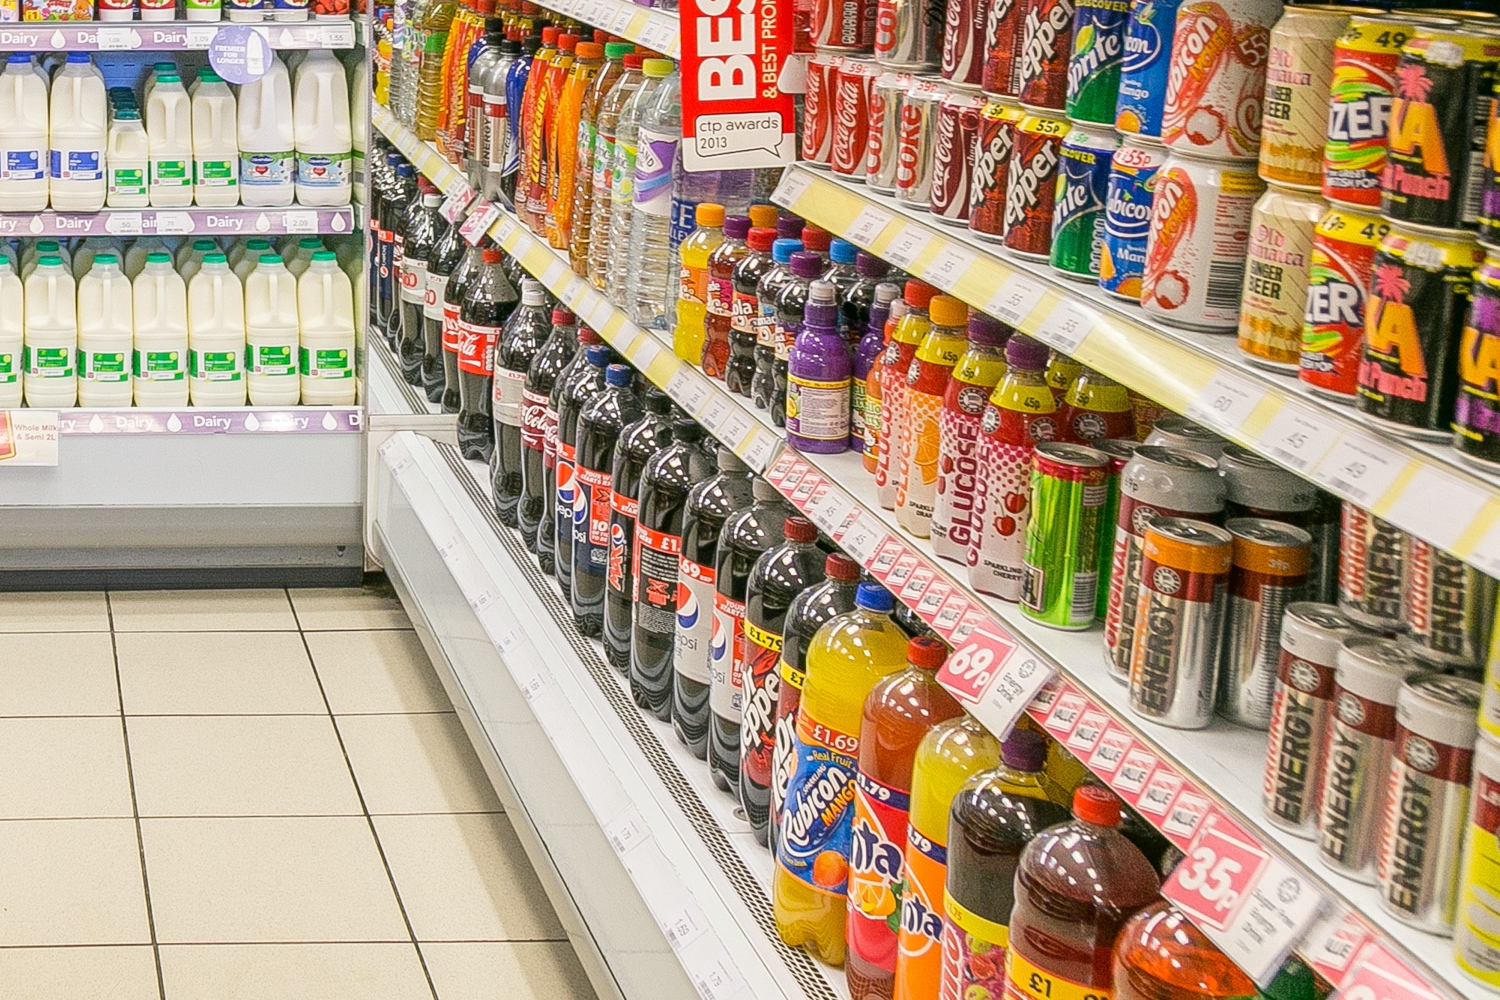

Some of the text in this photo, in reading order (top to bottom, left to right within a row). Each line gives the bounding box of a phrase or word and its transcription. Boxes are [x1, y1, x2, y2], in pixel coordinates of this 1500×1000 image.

[1, 32, 39, 46] Dairy
[762, 43, 778, 79] BEST
[1066, 31, 1121, 94] Sprite
[763, 83, 777, 99] &
[699, 116, 778, 134] ctp awards
[699, 136, 728, 151] 2013
[896, 102, 923, 188] COKE
[55, 215, 92, 230] Dairy
[1249, 280, 1281, 301] BEER
[15, 423, 57, 432] Whole Milk
[25, 433, 43, 441] Semi
[45, 433, 56, 441] 2L
[875, 370, 895, 488] GLUCOSE
[896, 400, 914, 508] GLUCOSE
[951, 419, 980, 546] GLUCOSE
[965, 443, 991, 568] GLUCOSE
[983, 558, 1022, 573] SPARKLING
[992, 569, 1023, 581] CHERRY
[749, 624, 783, 650] £1.79
[952, 644, 991, 689] 69p
[813, 726, 859, 752] £1.69
[813, 750, 852, 768] Real Fruit
[1273, 692, 1319, 822] ENERGY
[782, 766, 847, 844] Rubicon
[820, 779, 857, 828] MANGO
[1323, 722, 1365, 862] ENERGY
[1400, 769, 1434, 912] ENERGY
[1177, 847, 1243, 910] 35p
[1029, 972, 1053, 998] £1
